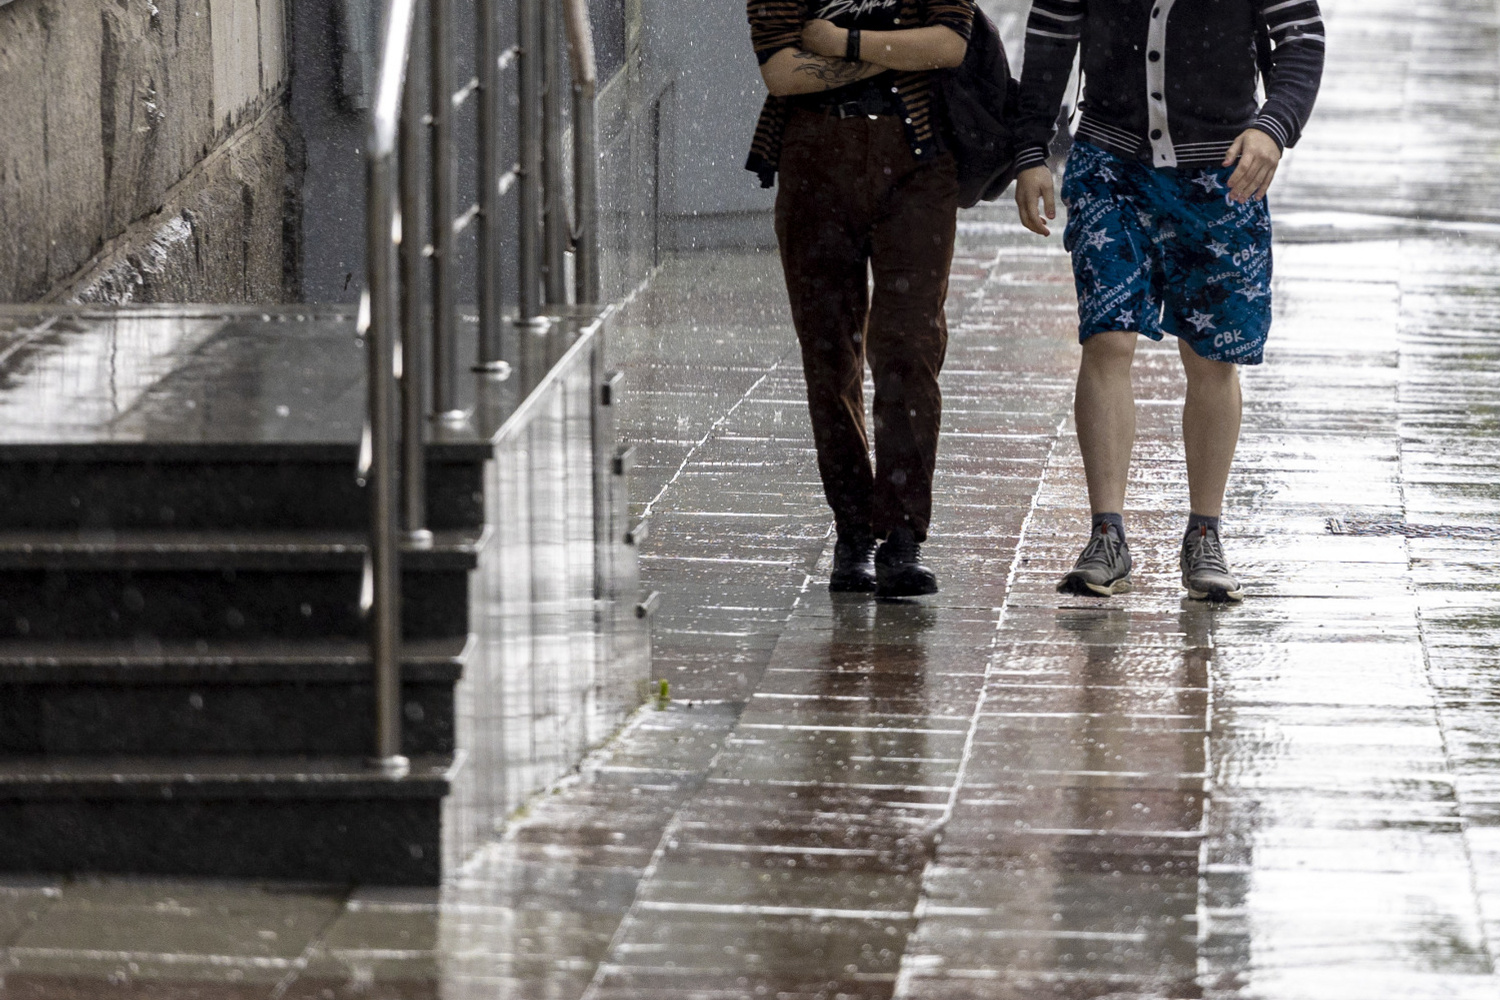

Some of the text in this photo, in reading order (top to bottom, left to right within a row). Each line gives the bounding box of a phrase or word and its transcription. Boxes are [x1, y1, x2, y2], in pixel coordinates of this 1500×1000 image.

[1232, 242, 1260, 267] CBK
[1207, 271, 1241, 283] CLASSIC
[1214, 328, 1246, 348] CBK
[1224, 335, 1262, 357] FASHION
